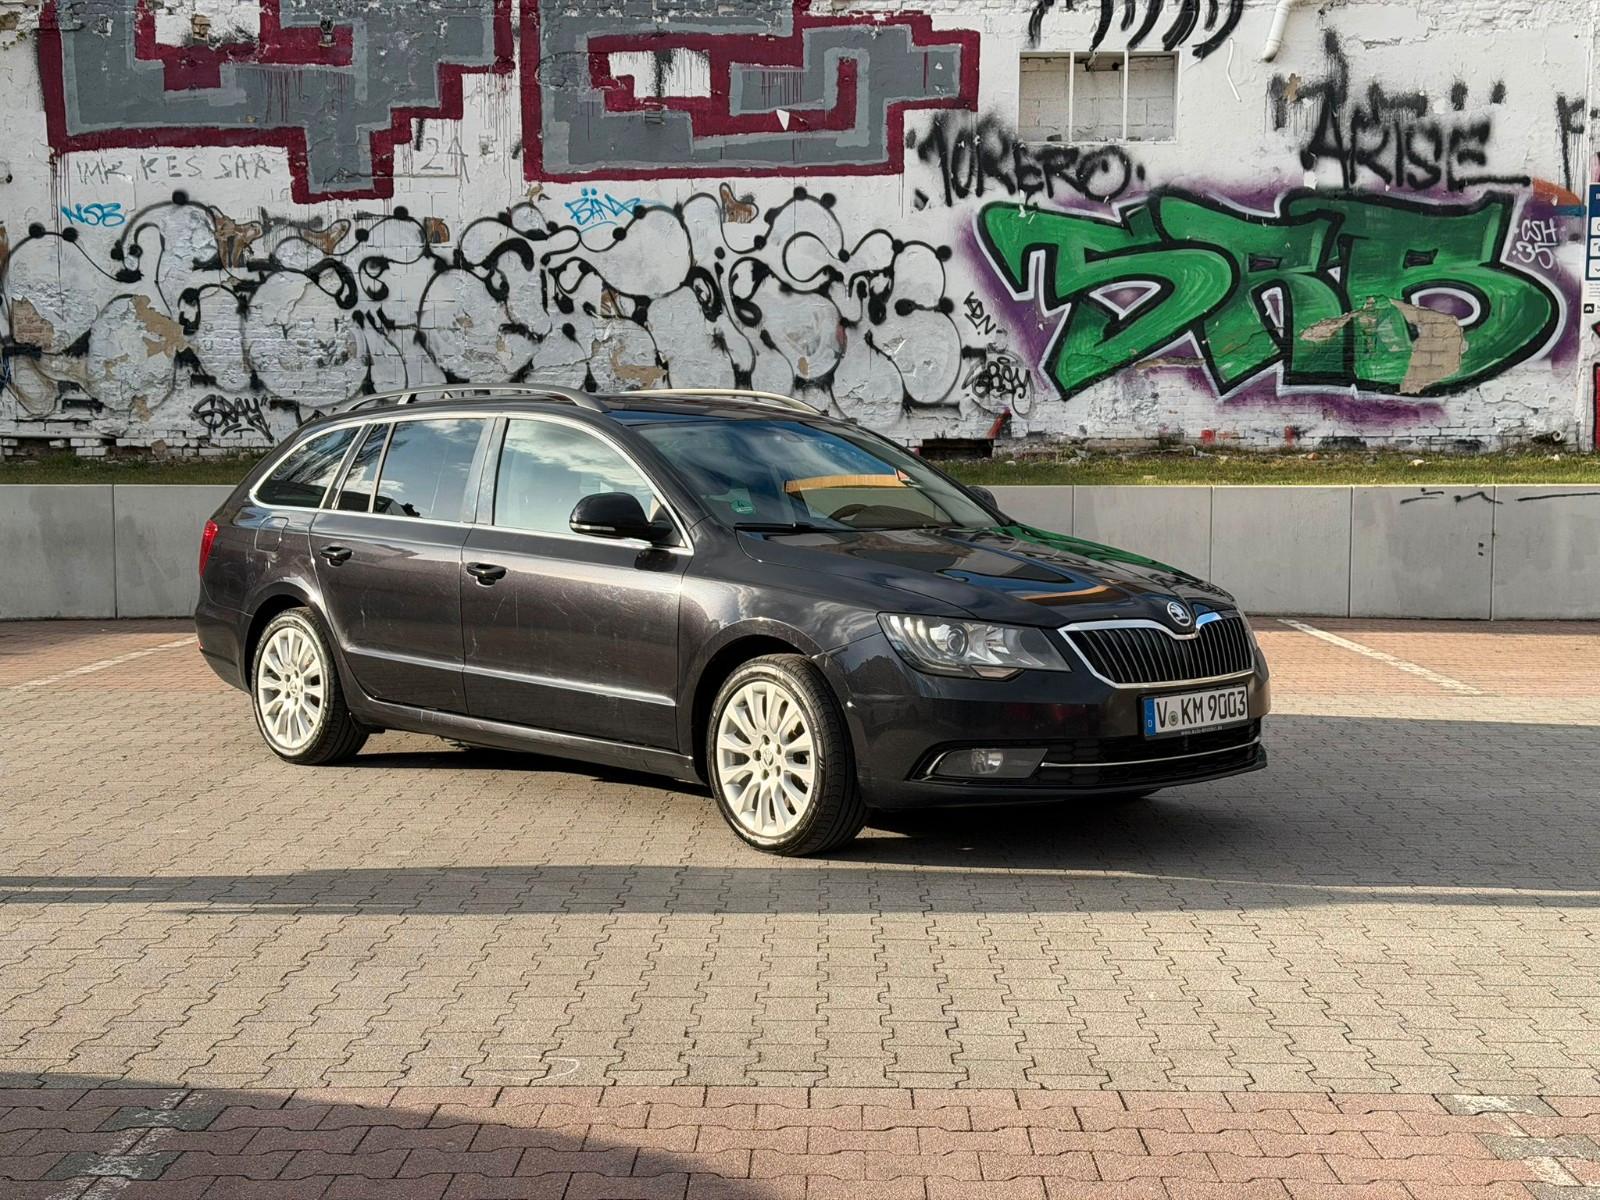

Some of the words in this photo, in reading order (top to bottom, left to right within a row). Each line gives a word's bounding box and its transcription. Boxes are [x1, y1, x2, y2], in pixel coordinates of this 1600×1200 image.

[1516, 241, 1558, 270] 35
[1156, 700, 1168, 729] V
[1181, 697, 1204, 725] KM
[1208, 692, 1246, 721] 9003
